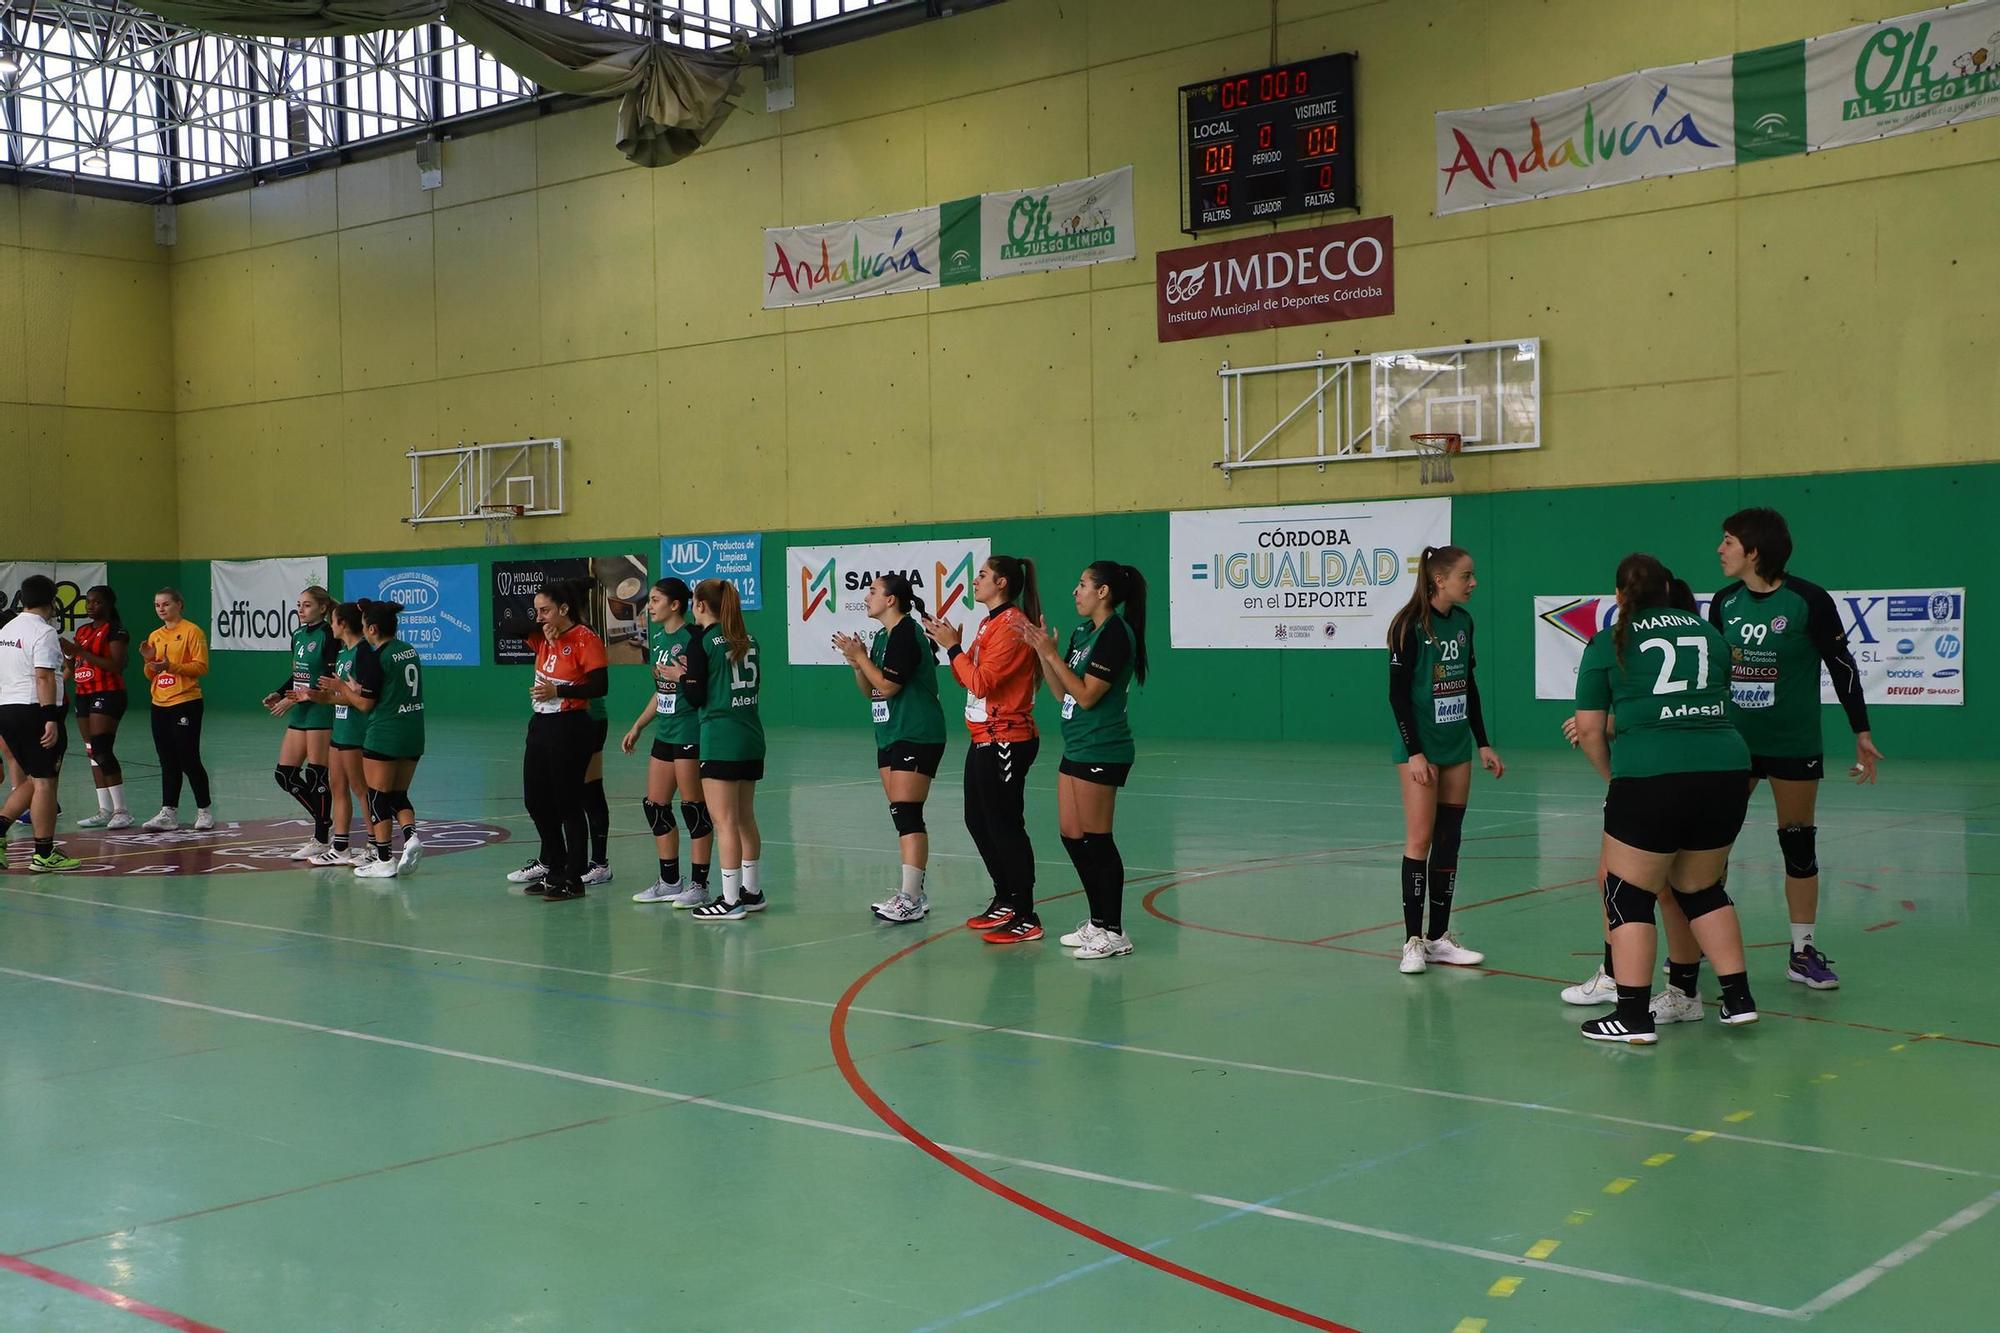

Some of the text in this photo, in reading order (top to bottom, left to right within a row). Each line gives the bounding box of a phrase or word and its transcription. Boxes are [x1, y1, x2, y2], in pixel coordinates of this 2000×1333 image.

[1855, 21, 1948, 97] Ok
[1850, 100, 1877, 119] AL
[1885, 82, 1956, 112] JUEGO
[1295, 100, 1336, 119] VISITANTE
[1193, 121, 1234, 138] LOCAL
[1308, 125, 1337, 156] 00
[1440, 85, 1720, 195] Andalucía
[1205, 144, 1233, 173] 00
[1252, 150, 1281, 165] PERIODO
[1304, 192, 1335, 207] FALTAS
[1203, 209, 1231, 223] FALTAS
[1253, 201, 1281, 216] JUGADOR
[1008, 194, 1058, 244] Ok
[1004, 246, 1020, 259] AL
[1024, 239, 1064, 254] JUEGO
[1068, 230, 1112, 249] LIMPIO
[769, 227, 931, 294] Andalucía
[1213, 236, 1383, 297] IMDECO
[1168, 285, 1383, 324] Instituto Municipal de Deportes Córdoba
[712, 539, 754, 551] Productos de
[1258, 528, 1351, 548] CÓRDOBA
[667, 543, 704, 564] JML
[719, 552, 747, 564] Limpieza
[716, 563, 752, 574] Profesional
[1214, 548, 1400, 589] IGUALDAD
[513, 572, 544, 583] HIDALGO
[742, 578, 755, 596] 12
[390, 589, 428, 605] GORITO
[1244, 591, 1367, 608] en el DEPORTE
[410, 616, 436, 624] BEBIDAS
[1632, 615, 1700, 632] MARINA
[408, 630, 418, 641] 77
[421, 629, 431, 641] 50
[1740, 623, 1767, 645] 99
[297, 645, 304, 658] 4
[1440, 640, 1459, 661] 28
[1744, 649, 1777, 657] Diputación
[1938, 634, 1957, 659] hp
[655, 649, 669, 665] 14
[1862, 651, 1884, 662] S.L.
[725, 648, 758, 690] 15
[1639, 636, 1709, 695] 27
[1736, 666, 1777, 676] IMDECO
[1887, 669, 1924, 678] brother
[404, 663, 419, 697] 9
[1440, 680, 1466, 691] IMDECO
[1887, 686, 1924, 695] DEVELOP
[1659, 701, 1724, 720] Adesal
